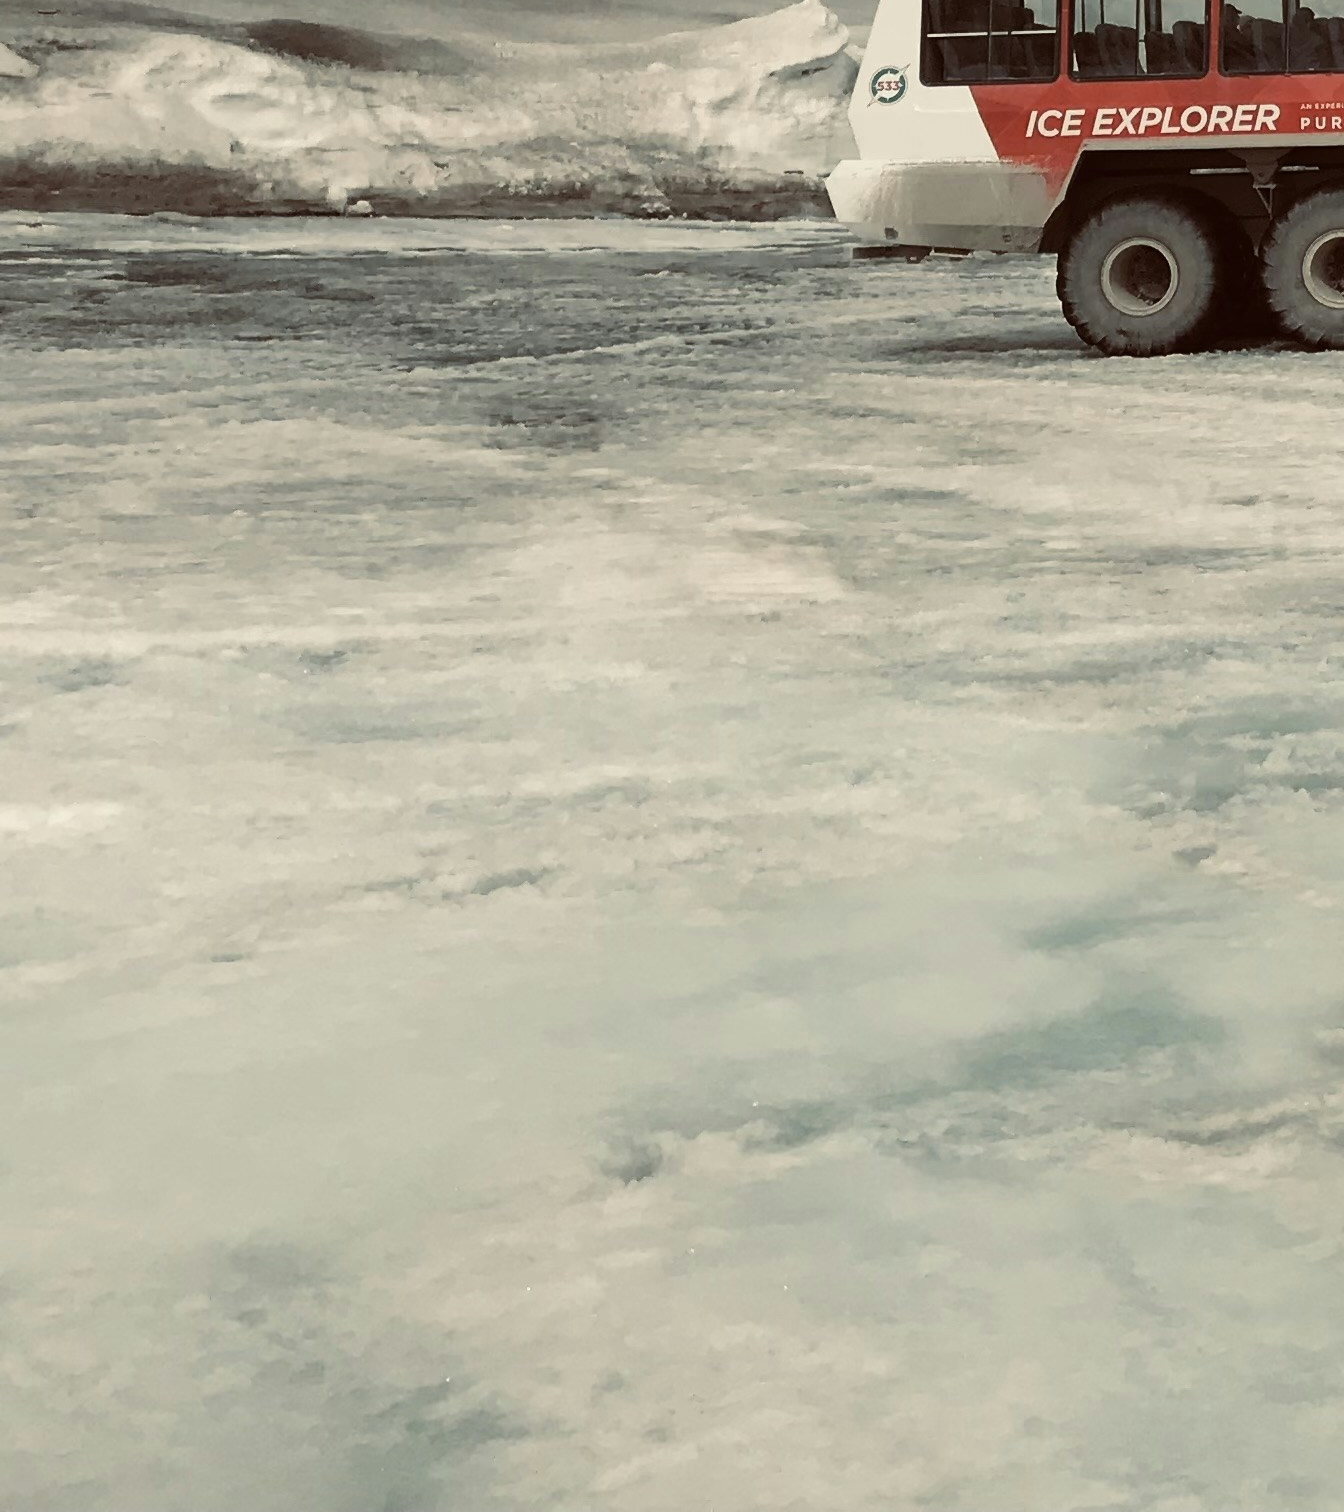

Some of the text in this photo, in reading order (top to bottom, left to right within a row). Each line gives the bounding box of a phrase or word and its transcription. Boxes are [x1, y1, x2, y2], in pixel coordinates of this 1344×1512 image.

[876, 80, 900, 91] 533
[1025, 104, 1281, 138] ICE EXPLORER
